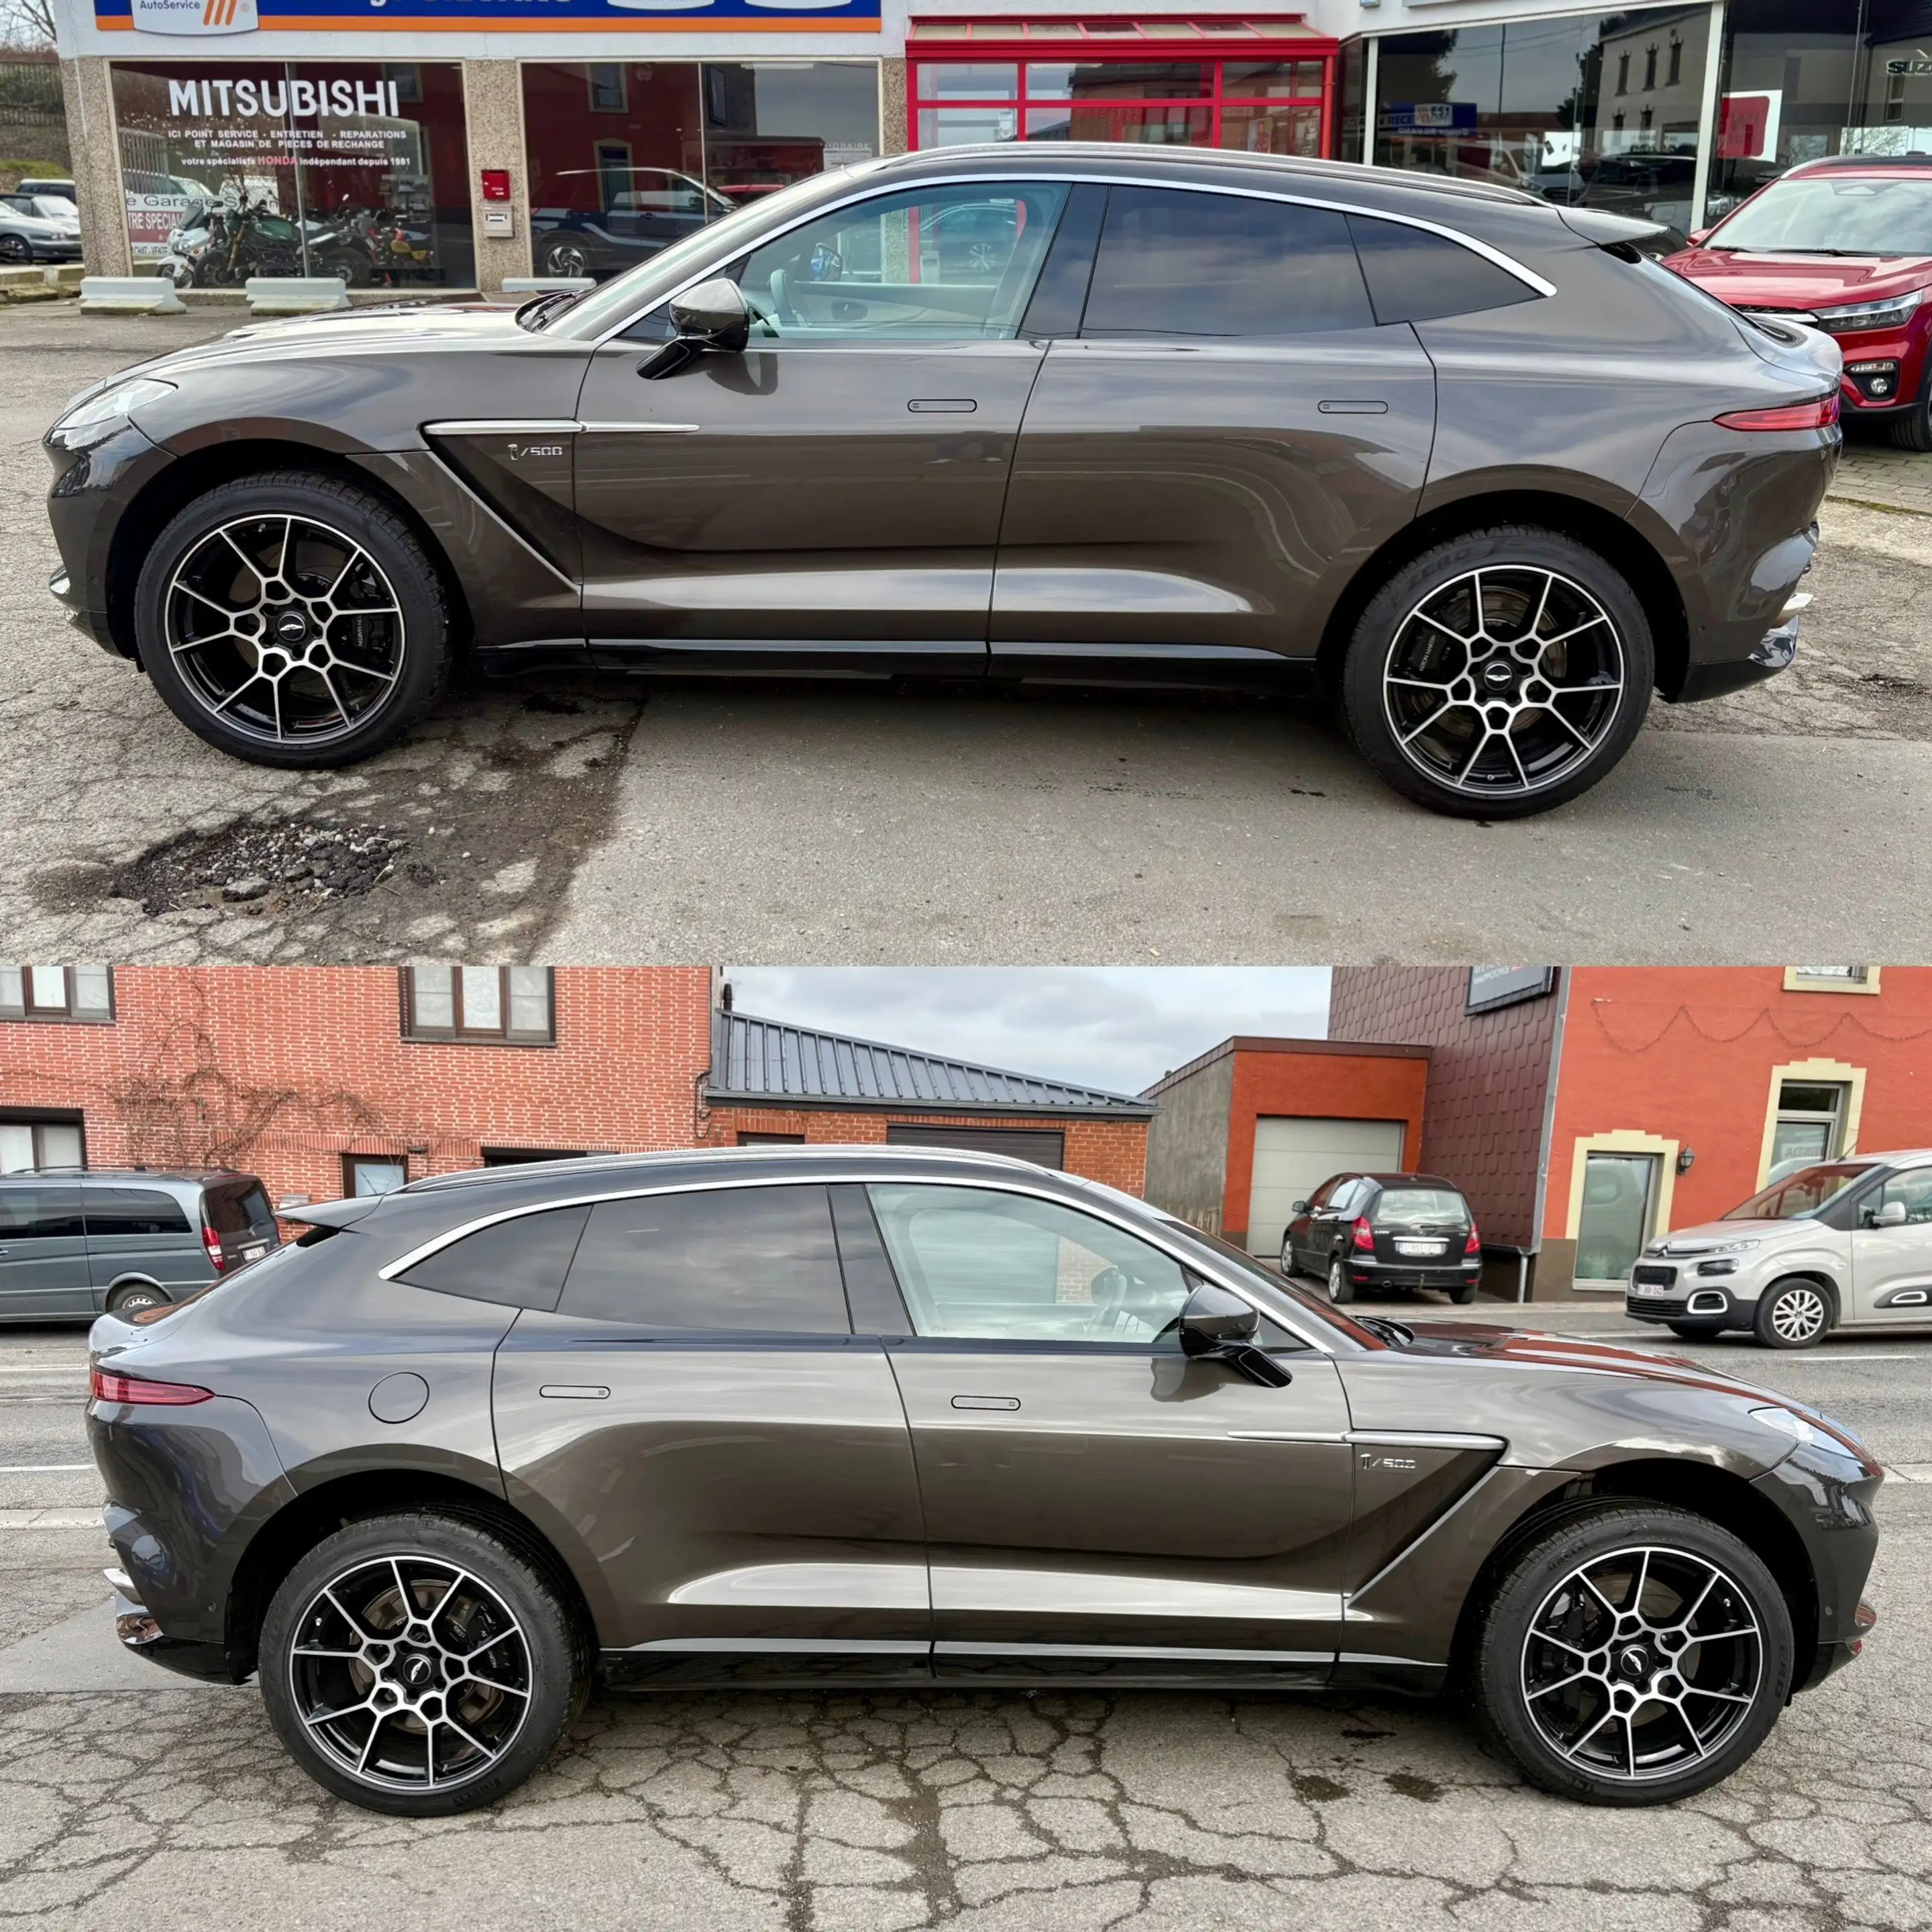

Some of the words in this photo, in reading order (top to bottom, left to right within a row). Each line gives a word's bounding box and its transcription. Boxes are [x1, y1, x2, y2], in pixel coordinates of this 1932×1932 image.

[140, 0, 201, 9] AutoService
[168, 79, 399, 117] MITSUBISHI
[168, 130, 181, 138] ICI
[185, 130, 213, 138] POINT
[217, 130, 258, 138] SERVICE
[270, 130, 323, 138] ENTRETIEN
[339, 130, 407, 139] REPARATIONS
[195, 140, 207, 148] ET
[211, 140, 255, 148] MAGASIN
[258, 140, 272, 148] DE
[278, 140, 313, 148] PIECES
[317, 140, 329, 149] DE
[331, 140, 385, 149] RECHANGE
[180, 157, 205, 166] votre
[207, 156, 256, 167] spécialiste
[257, 155, 298, 166] HONDA
[358, 156, 388, 167] depuis
[390, 157, 411, 166] 1981
